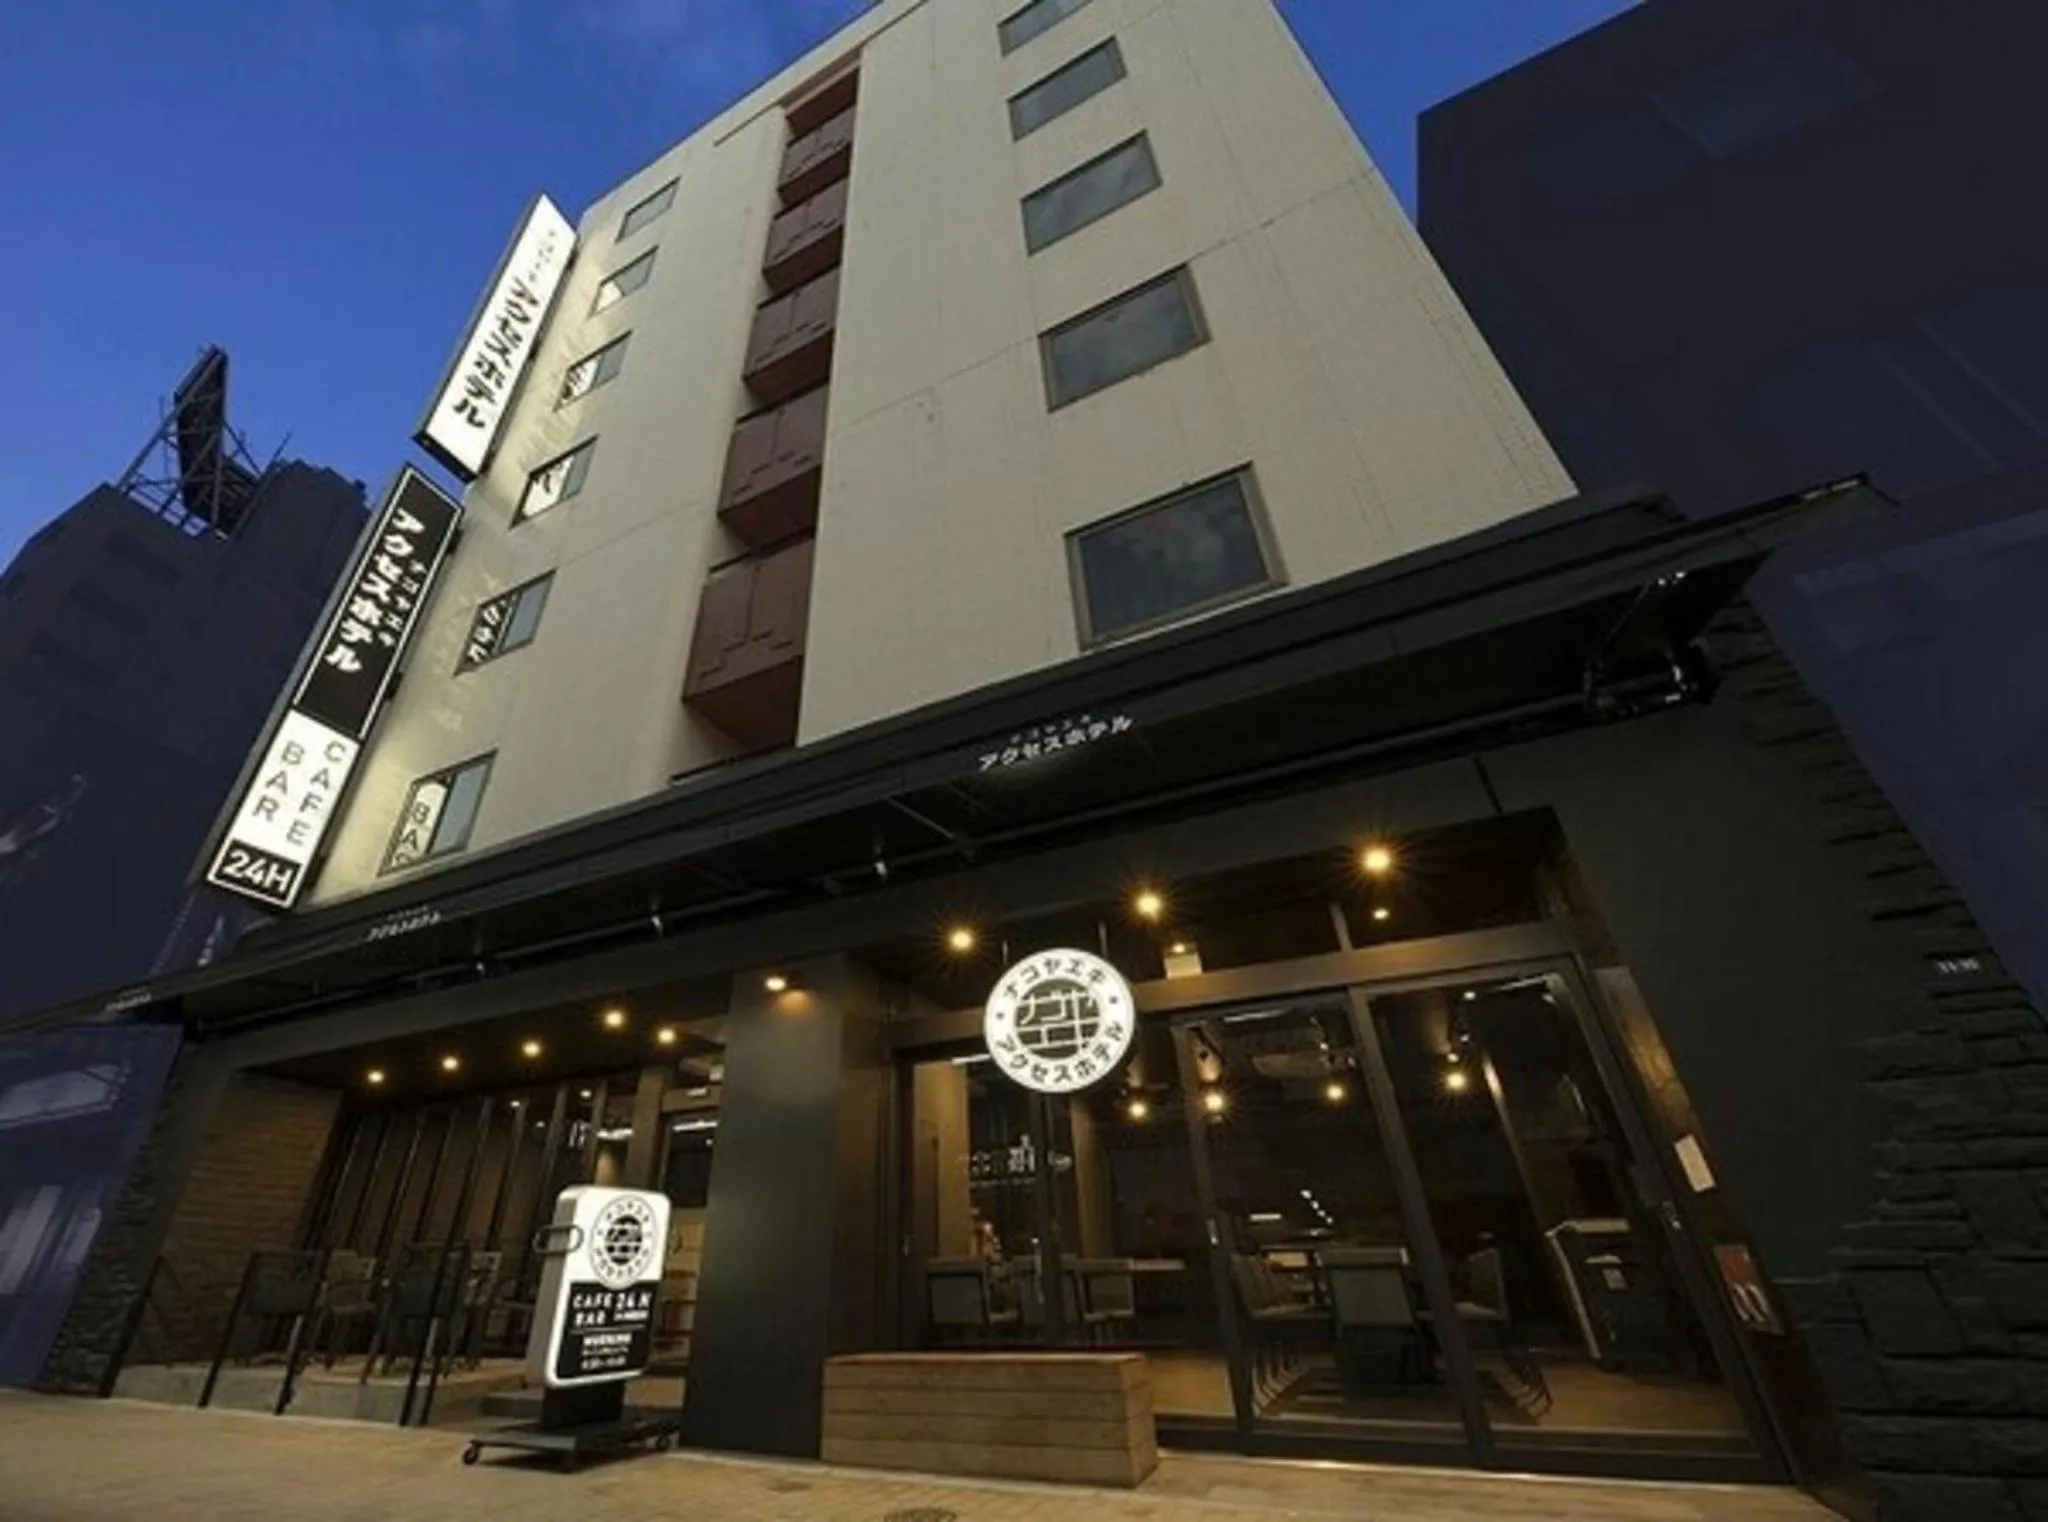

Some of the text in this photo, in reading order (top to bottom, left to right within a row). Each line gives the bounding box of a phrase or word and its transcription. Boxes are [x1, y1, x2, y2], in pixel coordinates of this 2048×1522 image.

[453, 276, 539, 428] アクセスホテル
[325, 507, 425, 674] アクセスホテル
[250, 741, 307, 824] BAR
[979, 715, 1132, 772] アクセスホテル
[286, 740, 347, 847] CAFE
[223, 849, 293, 896] 24H
[573, 1293, 613, 1309] CAFE
